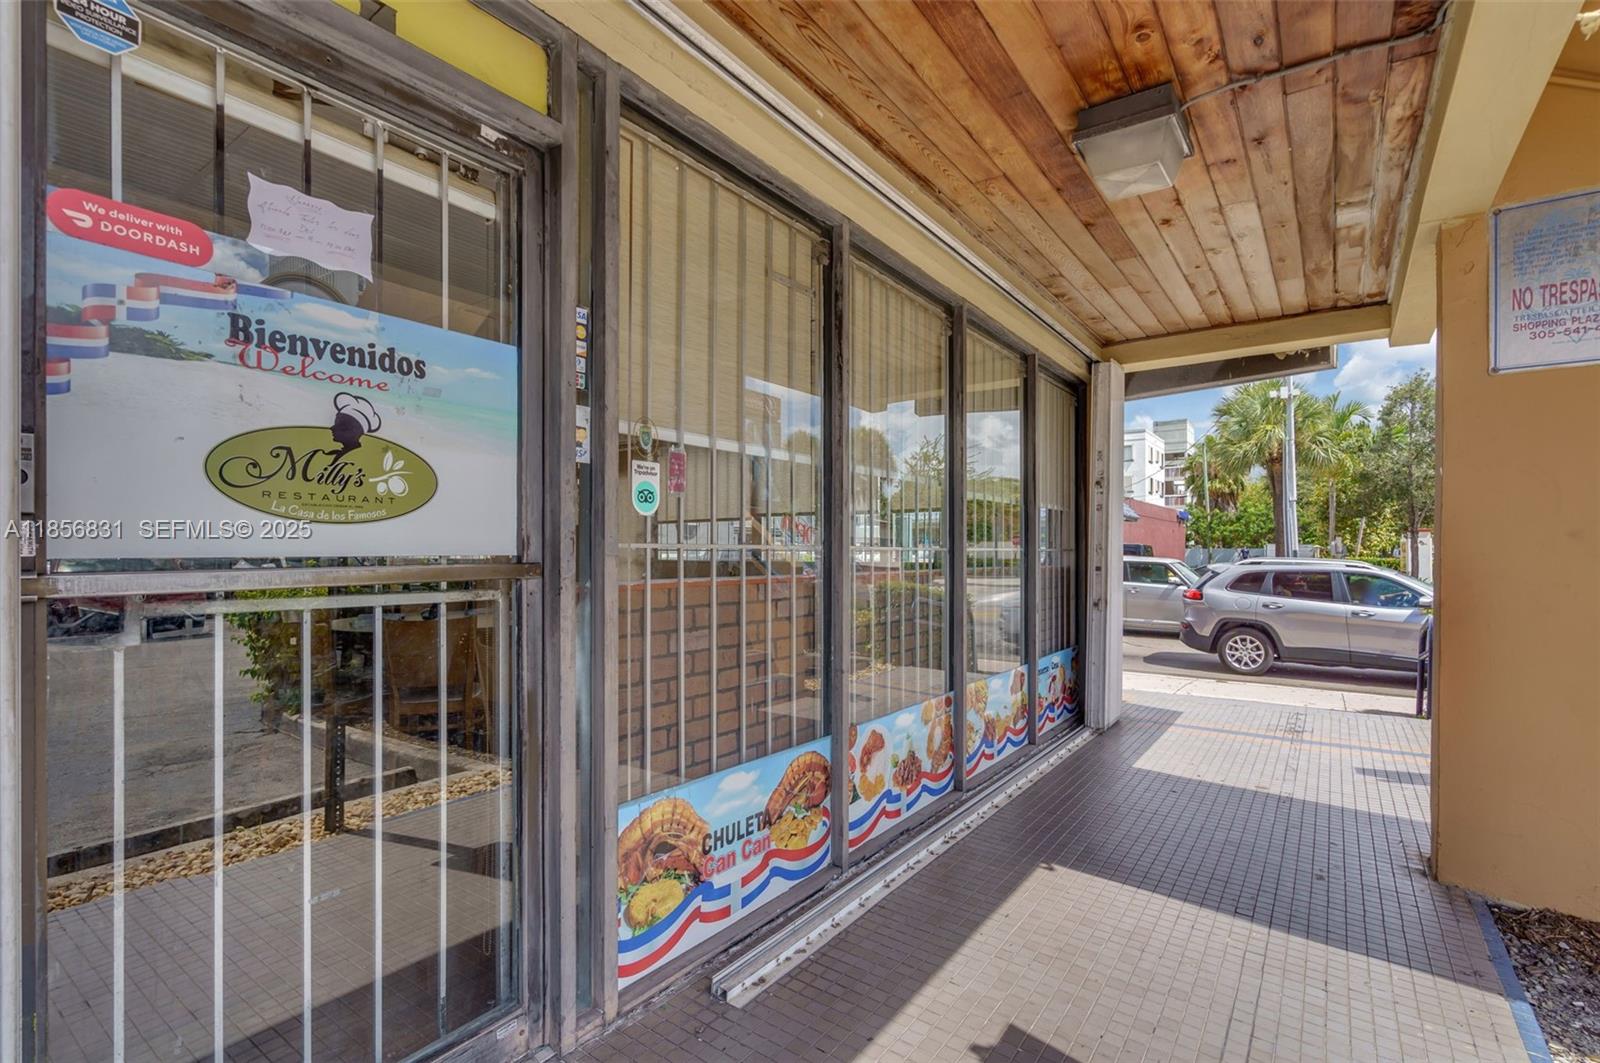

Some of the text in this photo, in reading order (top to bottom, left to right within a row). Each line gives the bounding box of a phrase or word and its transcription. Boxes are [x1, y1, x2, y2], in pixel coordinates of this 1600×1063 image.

[75, 11, 123, 36] PROTECTION
[85, 9, 137, 37] SURVEILLANCE
[90, 2, 127, 25] HOUR
[82, 201, 183, 237] We deliver with
[100, 221, 200, 256] DOORDASH
[1512, 278, 1600, 311] NO TRESPA
[1513, 318, 1567, 332] SHOPPING
[227, 312, 426, 379] Bienvenidos
[224, 338, 390, 391] Welcome
[218, 446, 366, 494] Milly's
[262, 490, 396, 504] RESTAURANT
[271, 500, 286, 512] La
[288, 505, 314, 519] Casa
[317, 509, 329, 520] de
[332, 510, 346, 521] los
[348, 508, 387, 521] Famosos
[702, 810, 773, 855] CHULETA
[703, 834, 772, 878] Can Can
